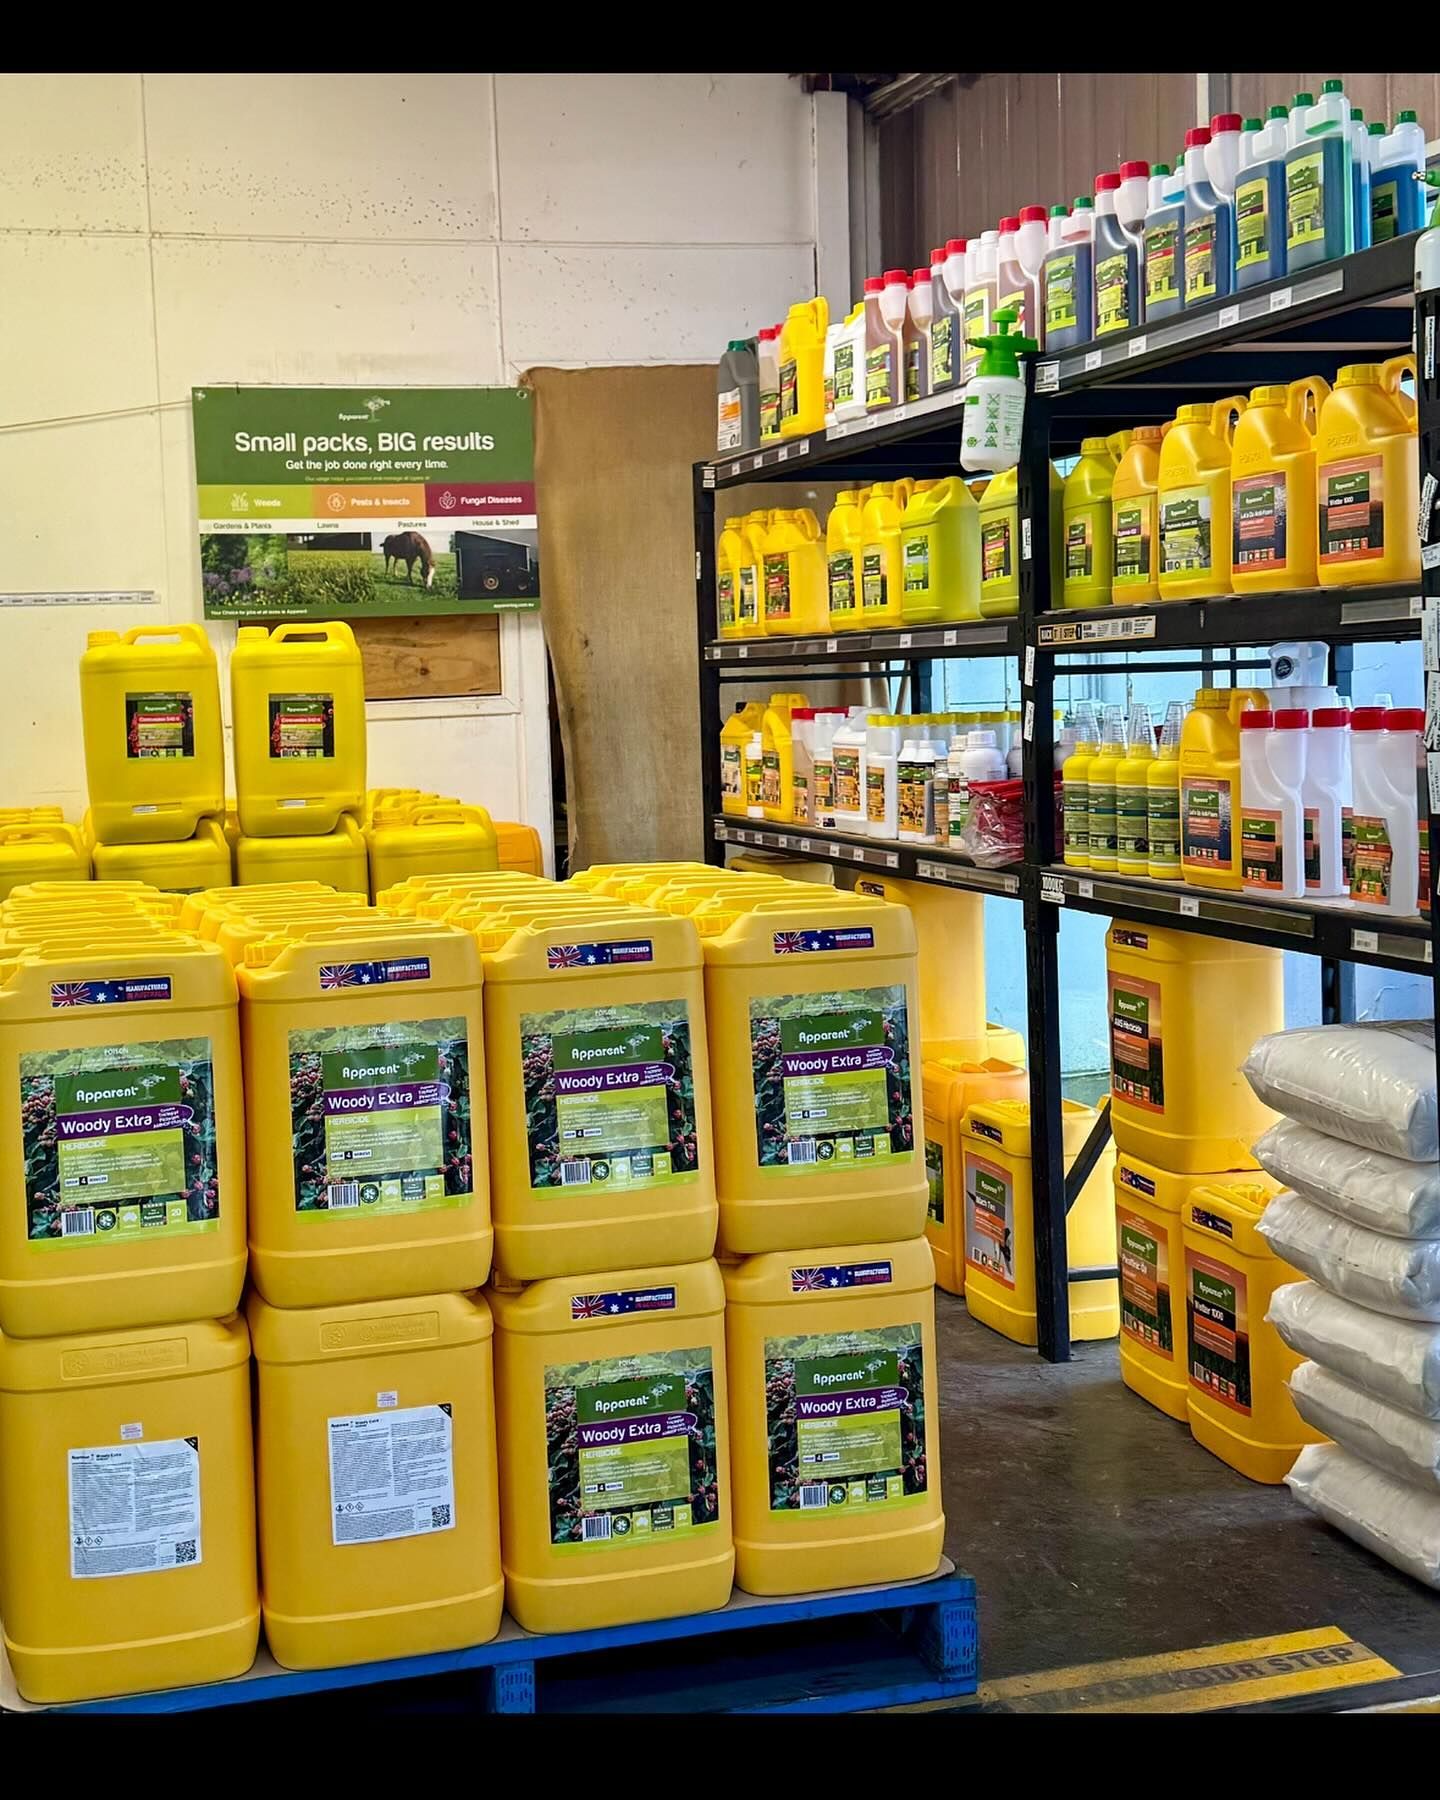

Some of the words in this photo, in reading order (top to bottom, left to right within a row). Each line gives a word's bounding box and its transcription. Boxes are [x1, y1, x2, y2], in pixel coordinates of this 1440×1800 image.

[235, 432, 296, 452] Small
[303, 433, 372, 456] packs,
[378, 432, 416, 451] BIG
[423, 432, 494, 451] results
[286, 460, 303, 470] Get
[306, 460, 322, 470] the
[325, 460, 340, 472] job
[342, 460, 367, 470] done
[370, 460, 392, 472] right
[394, 461, 422, 471] every
[425, 460, 448, 469] time.
[254, 499, 281, 507] Weeds
[351, 498, 372, 506] Pests
[382, 498, 410, 506] Insects
[461, 497, 486, 506] Fungal
[488, 496, 522, 504] Diseases
[214, 522, 242, 530] Gardens
[244, 522, 250, 530] &
[251, 522, 272, 530] Plants
[1042, 876, 1064, 892] 1000KG
[387, 964, 428, 974] MANUFACTURED
[125, 982, 168, 994] MANUFACTURED
[1118, 999, 1137, 1012] Apparent
[800, 1031, 848, 1044] Apparent
[104, 1047, 129, 1056] POISON
[572, 1046, 624, 1060] Apparent
[786, 1058, 828, 1072] Woody
[831, 1055, 862, 1068] Extra
[342, 1066, 398, 1080] Apparent
[559, 1075, 602, 1090] Woody
[606, 1072, 640, 1084] Extra
[76, 1087, 138, 1104] Apparent
[328, 1094, 374, 1110] Woody
[378, 1092, 412, 1106] Extra
[61, 1118, 111, 1136] Woody
[116, 1114, 153, 1128] Extra
[171, 1208, 182, 1216] 20
[1126, 1236, 1146, 1252] Apparent
[1200, 1281, 1224, 1298] Apparent
[814, 1372, 862, 1386] Apparent
[596, 1396, 646, 1412] Apparent
[800, 1400, 842, 1414] Woody
[846, 1396, 876, 1410] Extra
[582, 1428, 625, 1444] Woody
[629, 1423, 662, 1436] Extra
[1269, 1647, 1354, 1673] STEP
